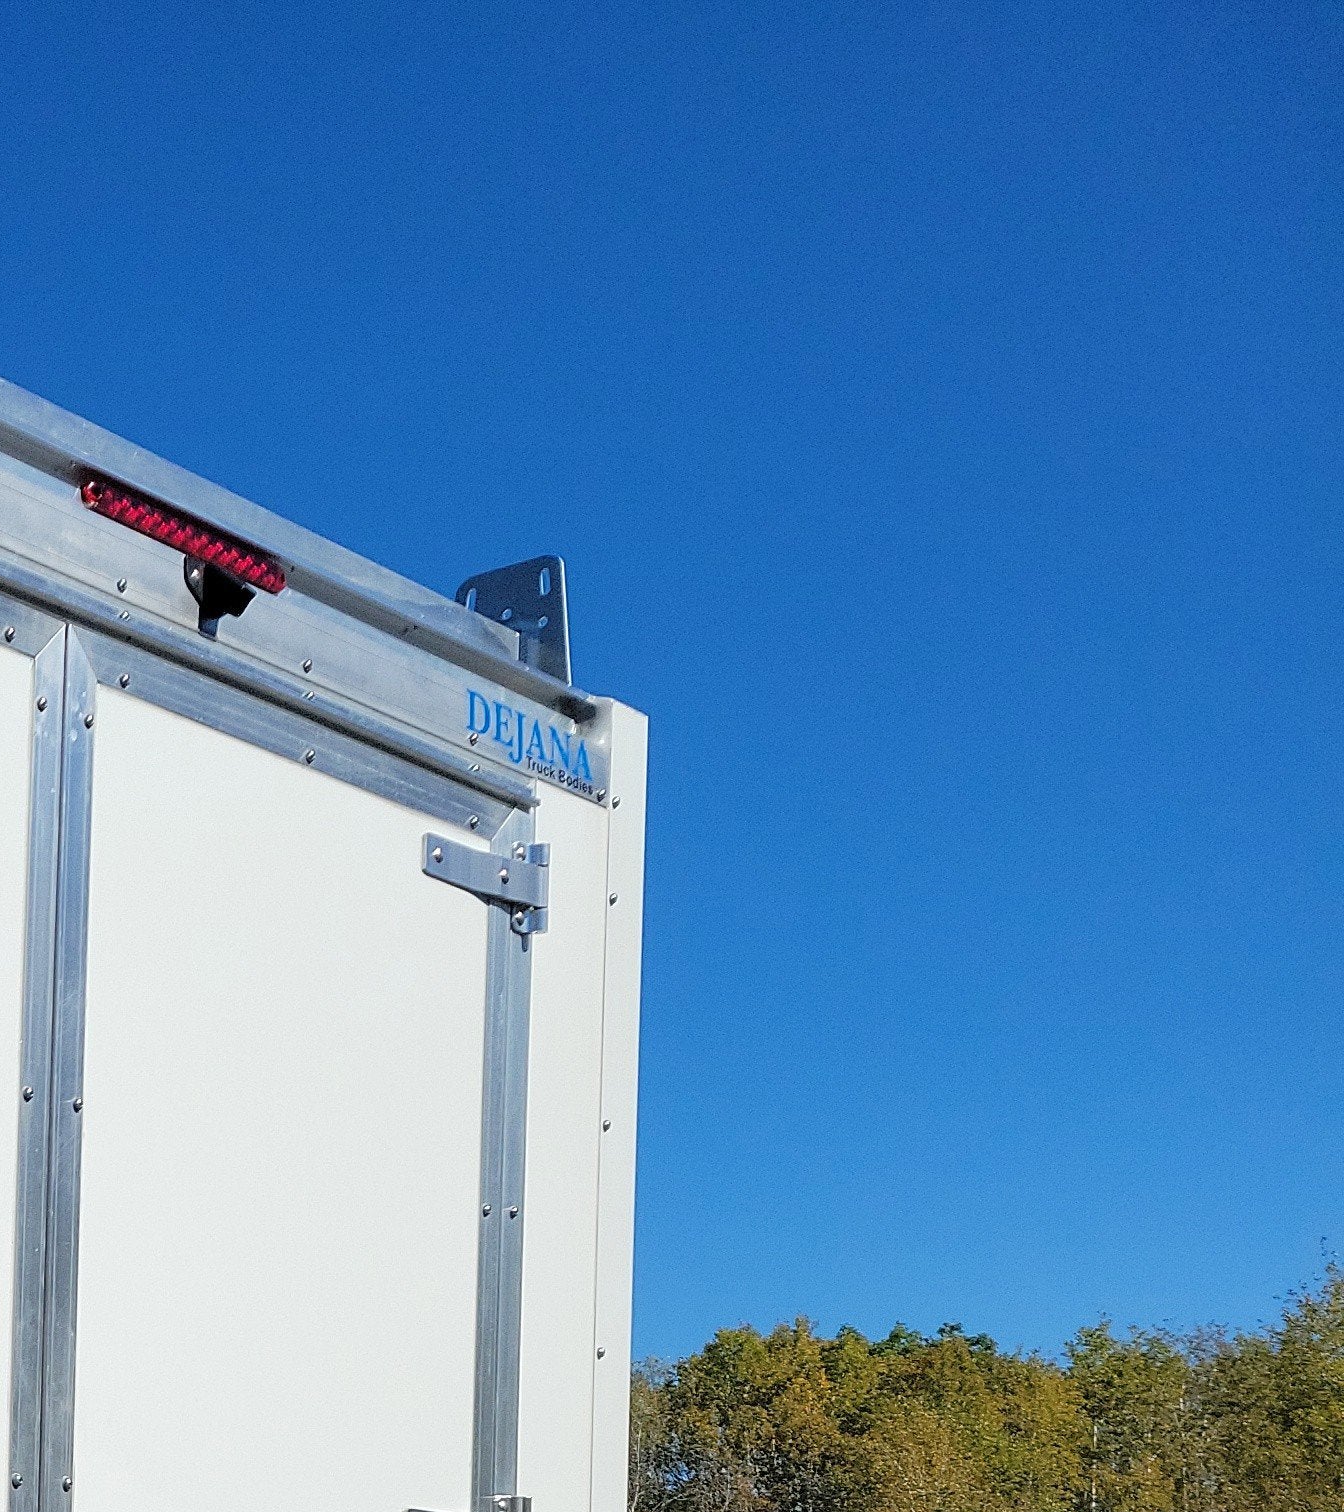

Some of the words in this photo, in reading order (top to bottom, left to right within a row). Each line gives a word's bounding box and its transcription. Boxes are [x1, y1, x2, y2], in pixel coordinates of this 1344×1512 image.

[466, 688, 593, 782] DEJANA
[525, 755, 556, 779] Truck
[558, 769, 594, 796] Bodies
